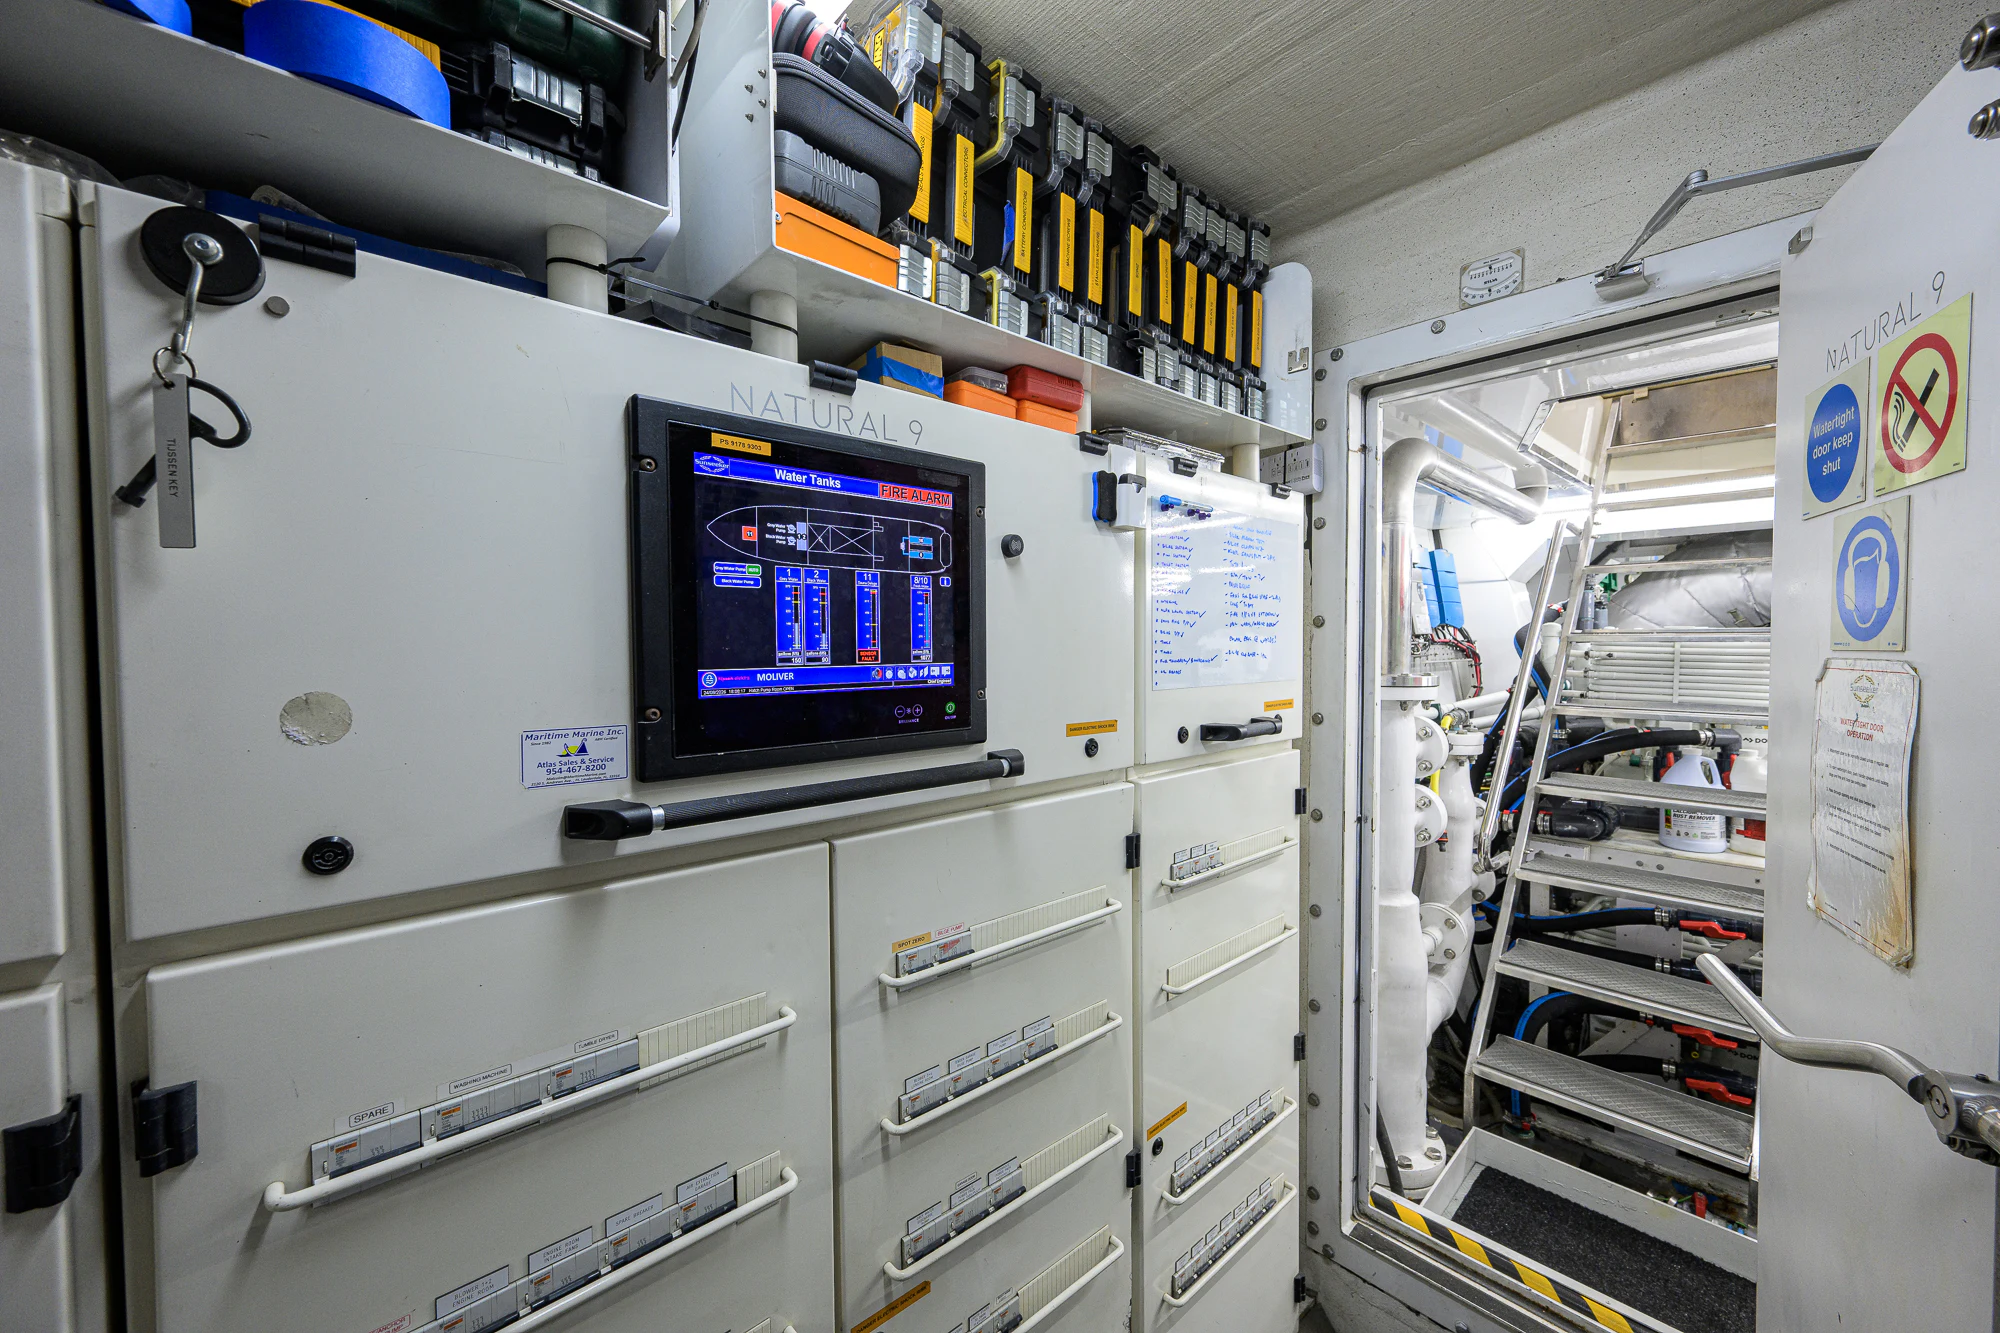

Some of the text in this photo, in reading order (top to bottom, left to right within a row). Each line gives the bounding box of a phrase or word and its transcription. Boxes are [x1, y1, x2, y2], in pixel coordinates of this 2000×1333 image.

[1020, 189, 1029, 257] BATTERY CONNECTORS
[1825, 270, 1945, 373] NATURAL 9
[730, 382, 923, 446] NATURAL 9
[1813, 405, 1855, 439] Watertight
[730, 440, 746, 449] 9178
[746, 442, 762, 451] 9303
[1812, 430, 1853, 461] door keep
[166, 438, 179, 498] TIJSSEN KEY
[694, 457, 730, 470] Sunseeker
[1822, 456, 1841, 476] shut
[775, 468, 841, 489] Water Tanks
[881, 485, 950, 506] FIRE ALARM
[787, 569, 791, 577] 1
[813, 570, 819, 578] 2
[914, 576, 928, 584] 8/10
[757, 673, 794, 681] MOLIVER
[1849, 681, 1880, 694] Sunseeker
[525, 728, 625, 741] Maritime Marine Inc.
[1846, 728, 1874, 742] OPERATION
[1869, 723, 1885, 734] DOOR
[546, 763, 607, 776] 954-467-8200
[937, 924, 963, 937] BILGE PUMP
[897, 936, 926, 949] SPOT ZERO
[578, 1034, 615, 1049] TUMBLE DRYER
[453, 1068, 508, 1090] WASHING MACHINE
[354, 1106, 389, 1124] SPARE
[685, 1170, 720, 1191] AIR EXTRACTION
[694, 1180, 712, 1192] GARAGE
[615, 1204, 654, 1227] SPARE BREAKER
[543, 1236, 580, 1258] ENGINE ROOM
[543, 1251, 563, 1263] INTAKE
[452, 1283, 495, 1308] ENGINE ROOM
[454, 1284, 479, 1300] BLOWER
[856, 1316, 877, 1333] DANGER
[876, 1302, 900, 1321] ELECTRIC
